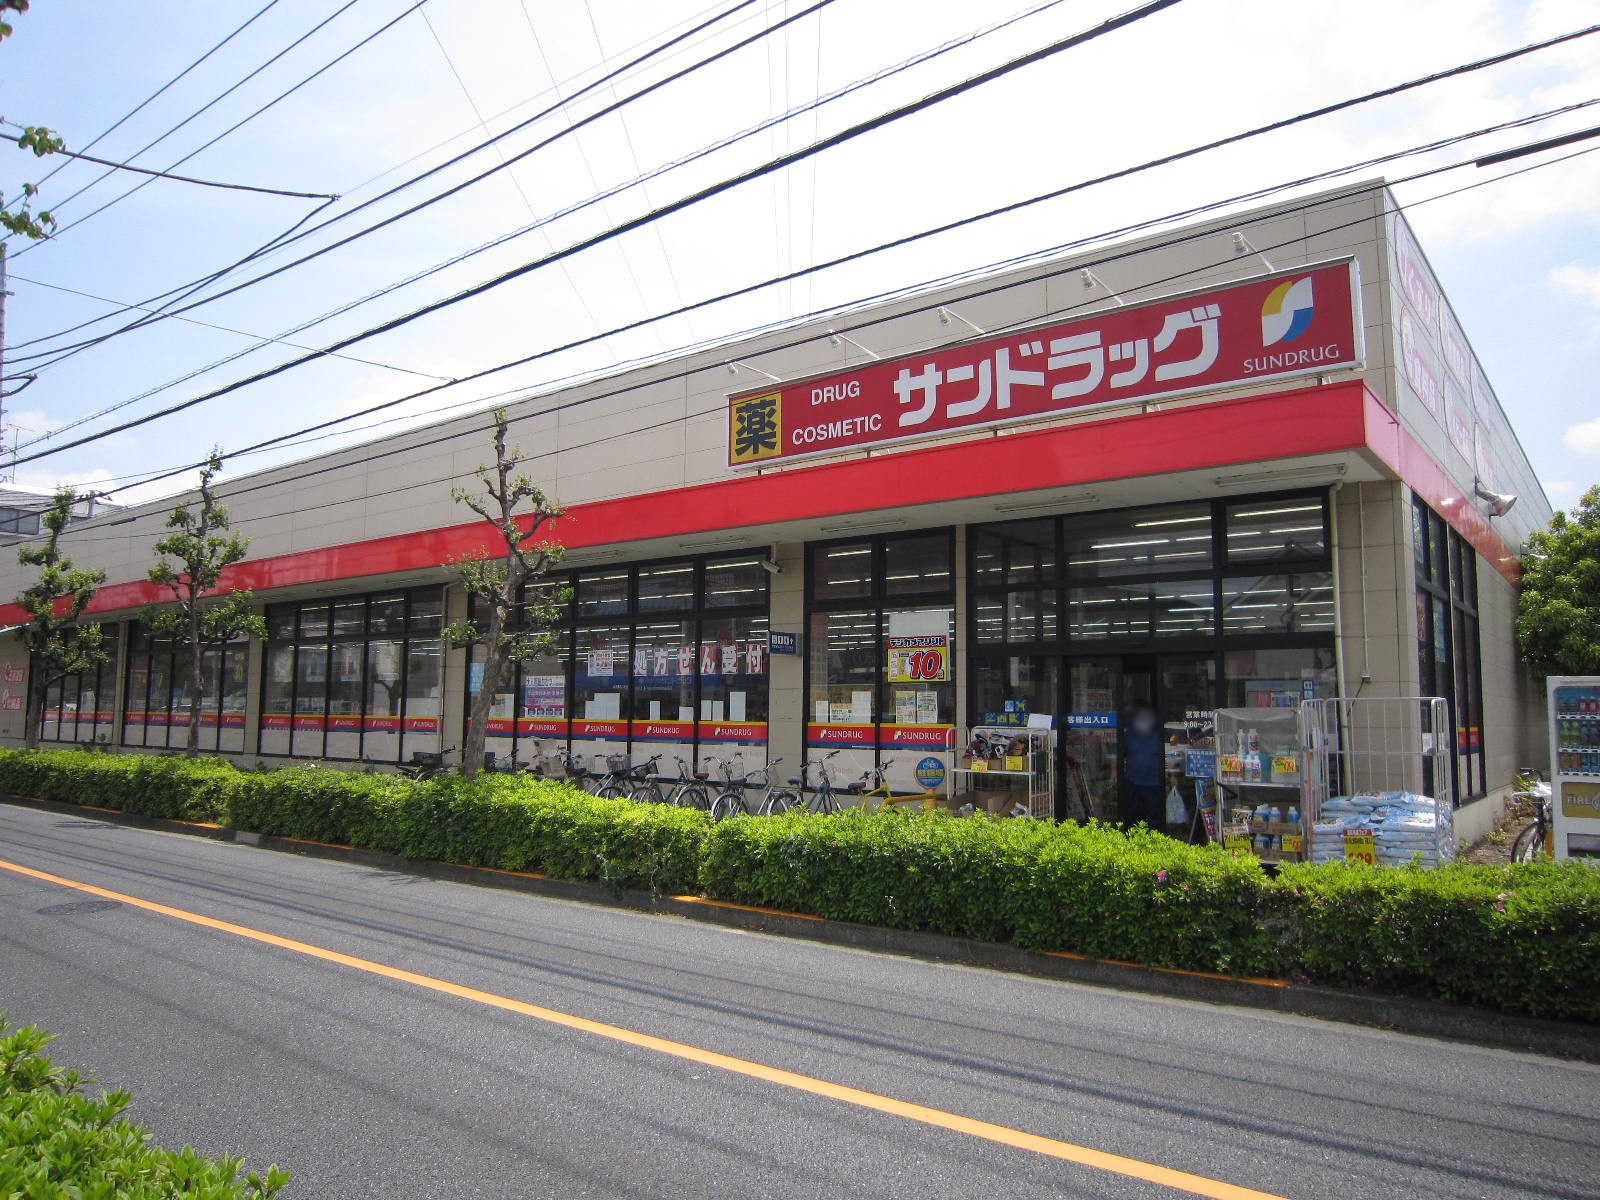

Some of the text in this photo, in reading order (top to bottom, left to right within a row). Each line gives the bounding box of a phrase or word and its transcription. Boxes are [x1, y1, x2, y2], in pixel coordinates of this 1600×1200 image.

[893, 303, 1222, 427] サンドラッグ
[1243, 344, 1340, 373] SUNDRUG
[811, 381, 861, 406] DRUG
[734, 398, 777, 457] 薬
[792, 413, 882, 445] COSMETIC
[634, 644, 763, 676] 処方せん受付
[589, 725, 616, 733] SUNDRUG
[652, 726, 680, 735] SUNDRUG
[721, 727, 753, 737] SUNDRUG
[827, 730, 863, 739] SUNDRUG
[902, 731, 942, 741] SUNDRUG
